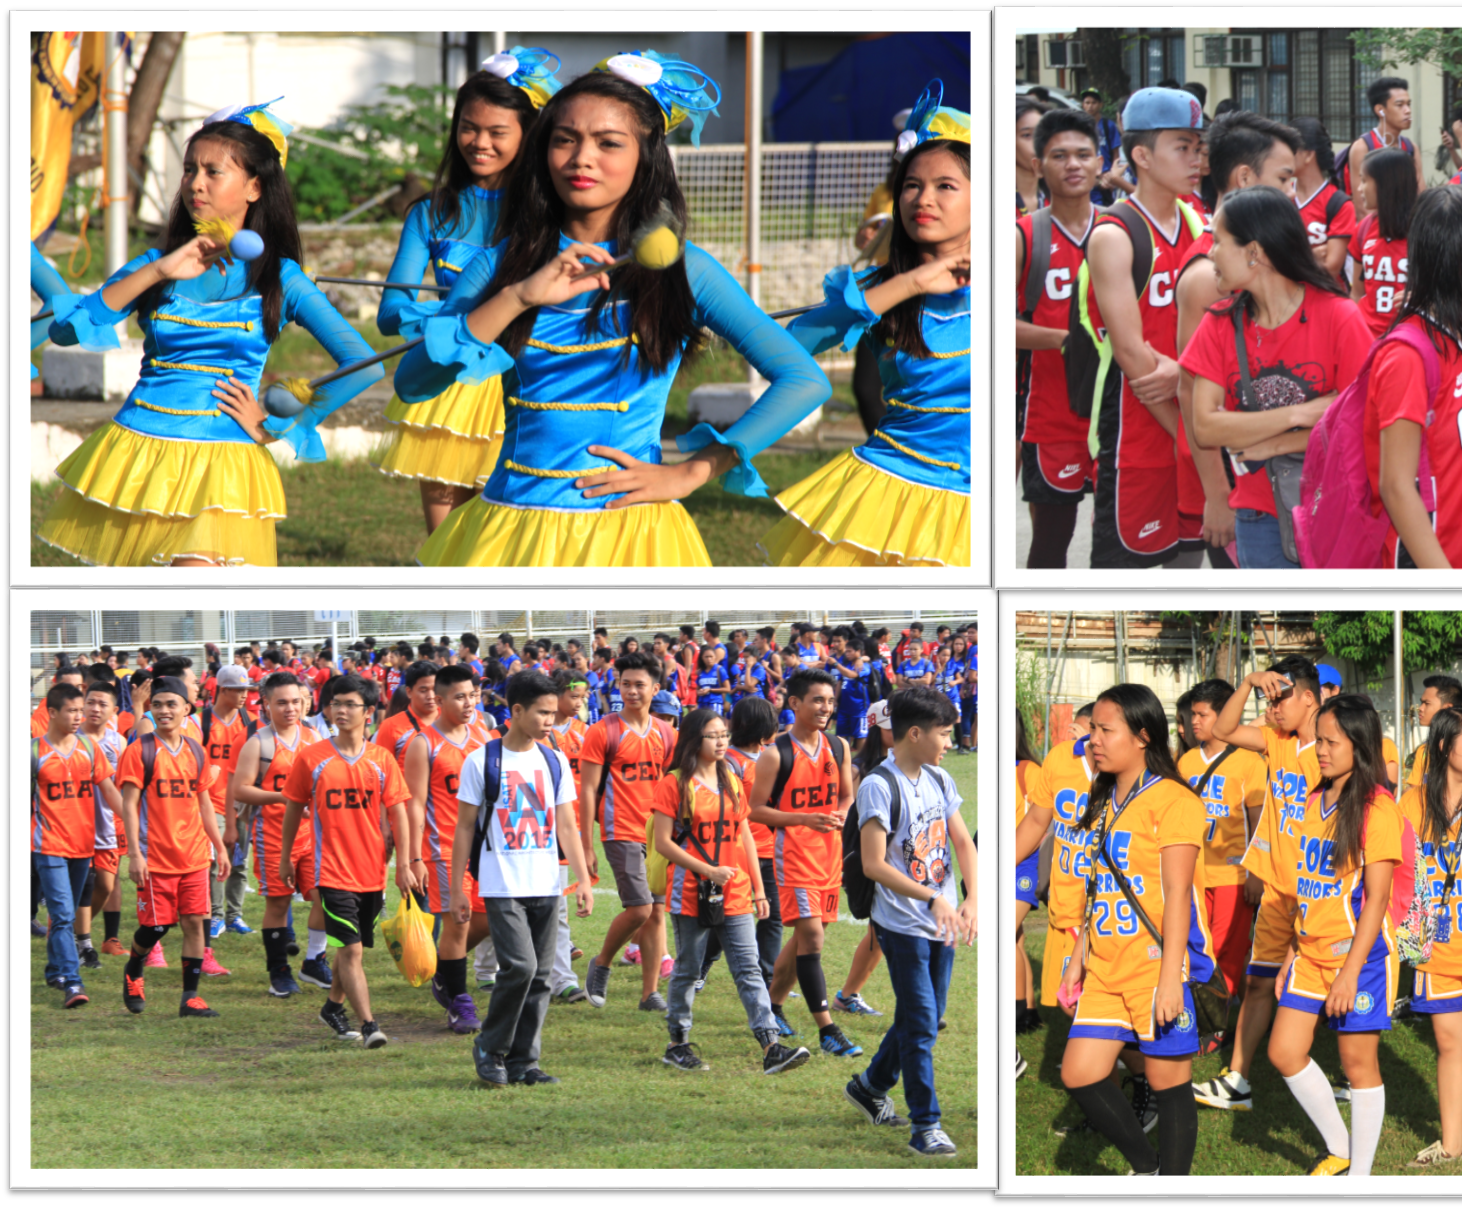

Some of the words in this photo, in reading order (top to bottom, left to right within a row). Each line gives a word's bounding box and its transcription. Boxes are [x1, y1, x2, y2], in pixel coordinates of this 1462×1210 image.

[1362, 254, 1409, 284] CAS
[1148, 269, 1179, 307] C
[1376, 286, 1394, 314] 8
[621, 761, 662, 782] CE
[47, 779, 93, 801] CEA
[503, 830, 553, 851] 2015
[698, 820, 739, 844] CE
[1093, 898, 1139, 937] 29
